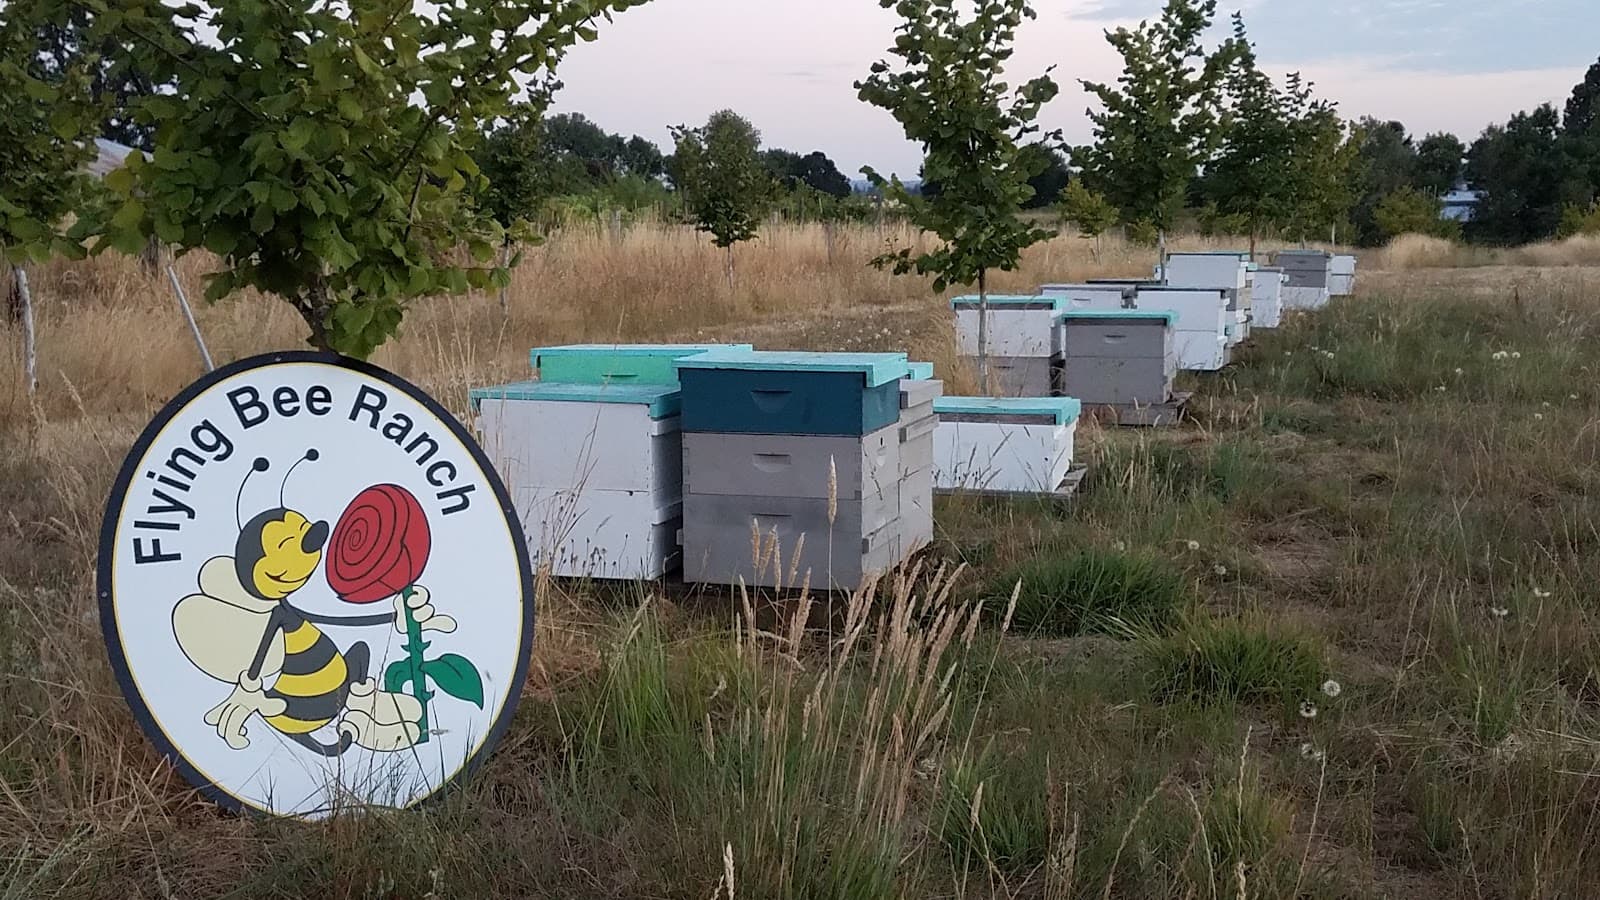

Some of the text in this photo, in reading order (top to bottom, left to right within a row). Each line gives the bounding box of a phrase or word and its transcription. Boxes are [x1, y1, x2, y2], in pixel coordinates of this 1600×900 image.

[133, 384, 477, 564] Flying Bee Ranch
